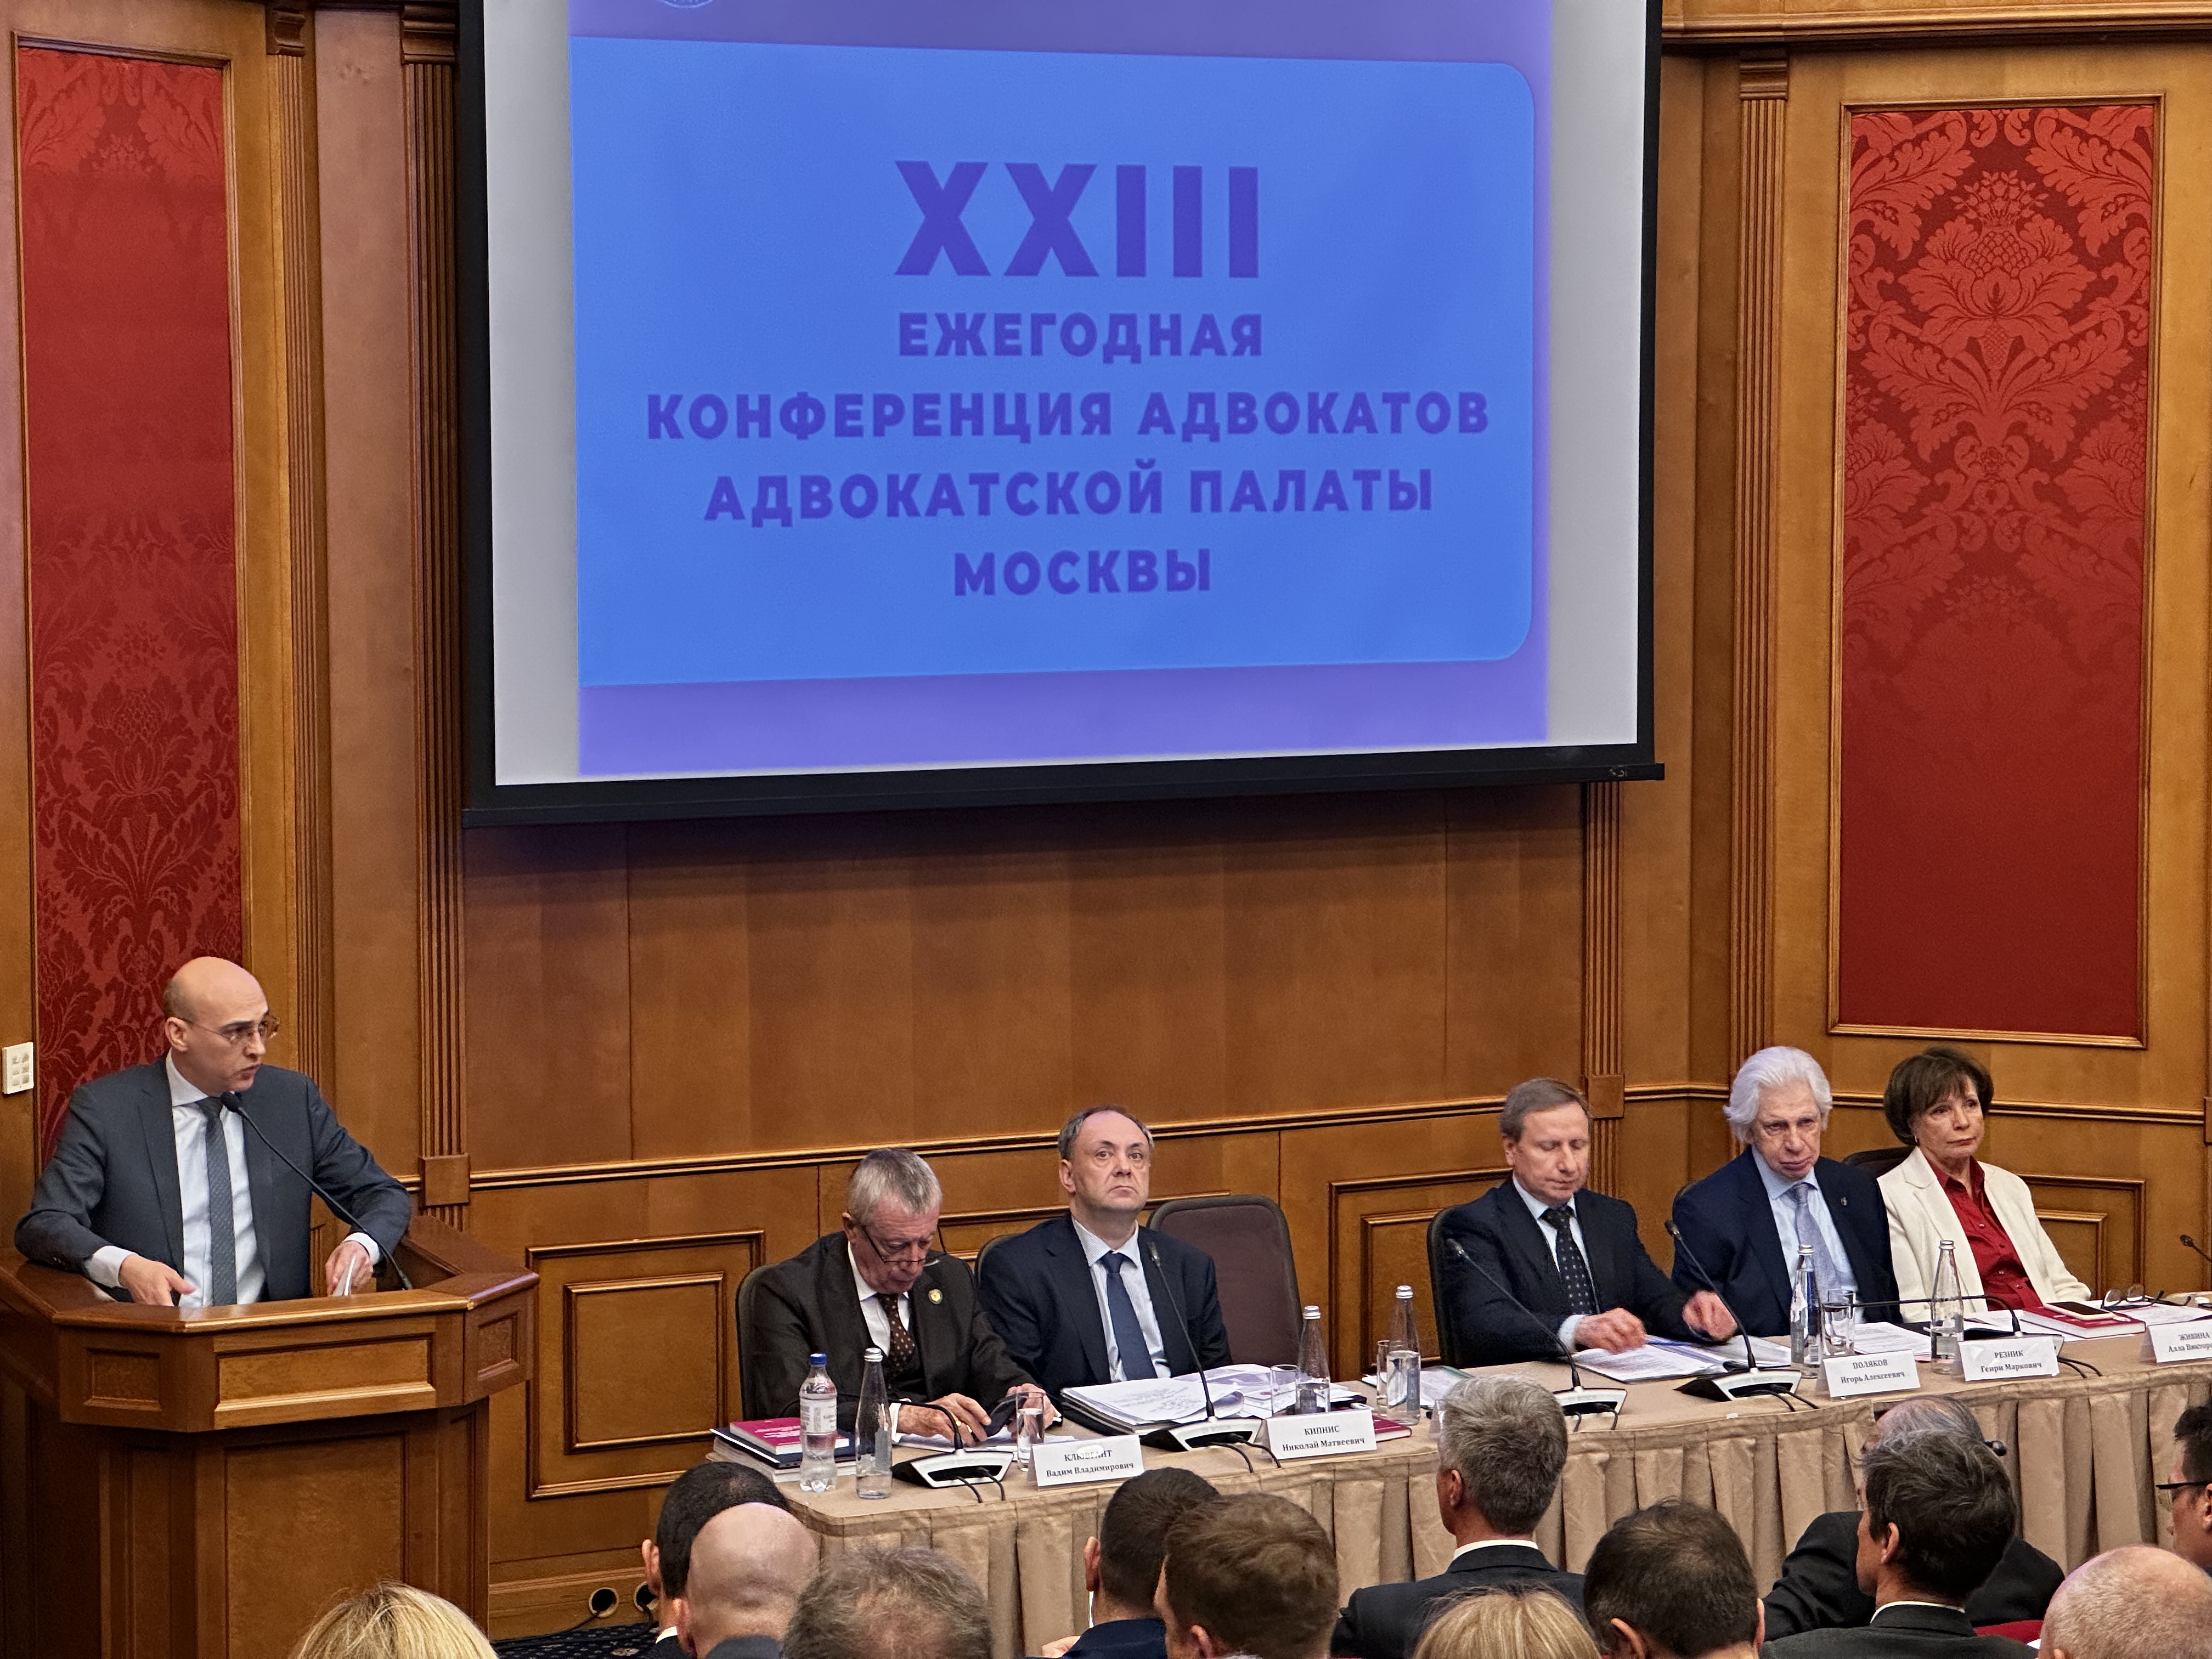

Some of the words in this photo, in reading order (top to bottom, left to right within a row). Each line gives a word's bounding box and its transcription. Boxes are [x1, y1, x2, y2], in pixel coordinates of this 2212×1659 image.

[895, 161, 1258, 278] XXIII
[900, 313, 1261, 364] ЕЖЕГОДНАЯ
[648, 392, 1111, 444] КОНФЕРЕНЦИЯ
[1138, 392, 1488, 442] АДВОКАТОВ
[704, 459, 1161, 528] АДВОКАТСКОЙ
[1190, 469, 1431, 512] ПАЛАТЫ
[955, 549, 1210, 596] МОСКВЫ
[1994, 1350, 2024, 1358] РЕЗНИК
[1852, 1359, 1888, 1369] ПОЛЯКОВ
[2005, 1362, 2042, 1372] Маркович
[1841, 1376, 1863, 1384] Игорь
[1864, 1371, 1905, 1381] Алексеевич
[1304, 1425, 1340, 1436] КИПНИС
[1283, 1441, 1319, 1452] Николай
[1321, 1437, 1365, 1448] Матвеевич
[1074, 1463, 1134, 1474] Владимирович
